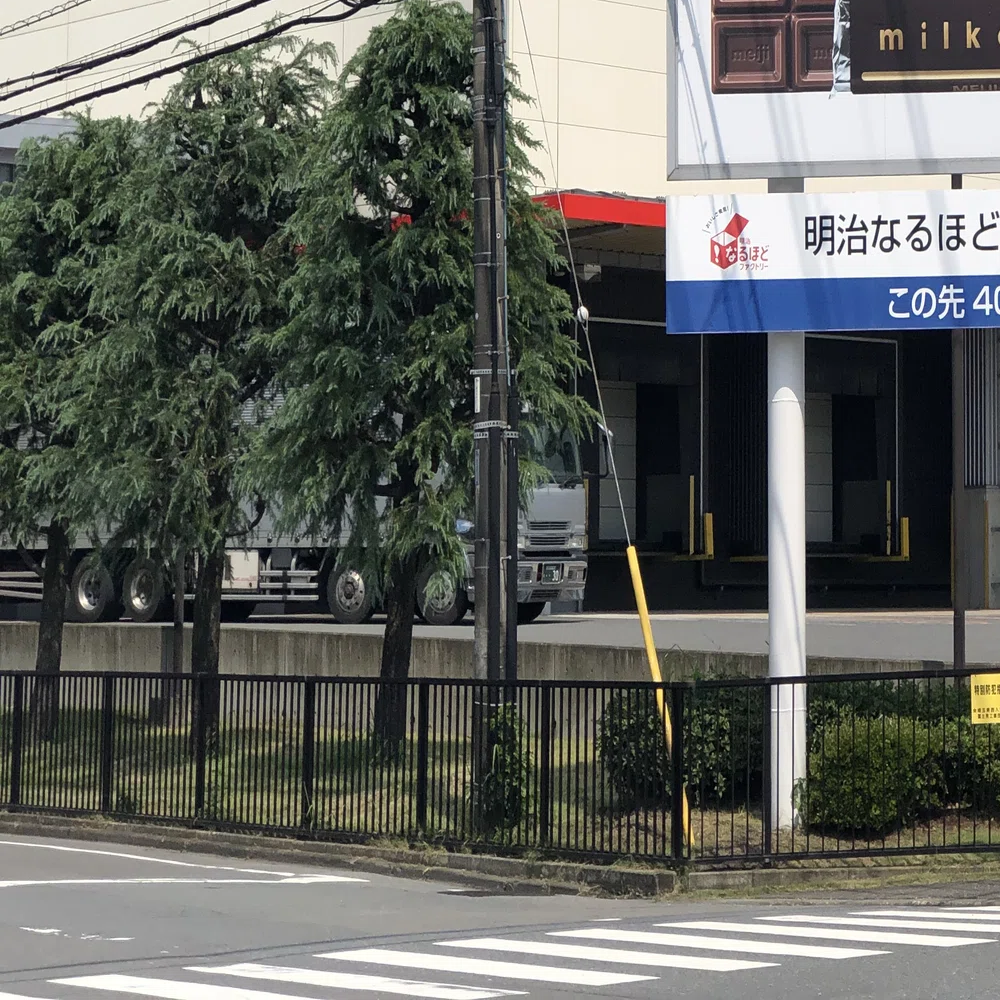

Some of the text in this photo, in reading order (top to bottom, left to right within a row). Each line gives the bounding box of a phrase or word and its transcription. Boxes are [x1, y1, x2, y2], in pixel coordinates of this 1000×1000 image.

[731, 44, 771, 68] meiji
[887, 284, 966, 320] この先
